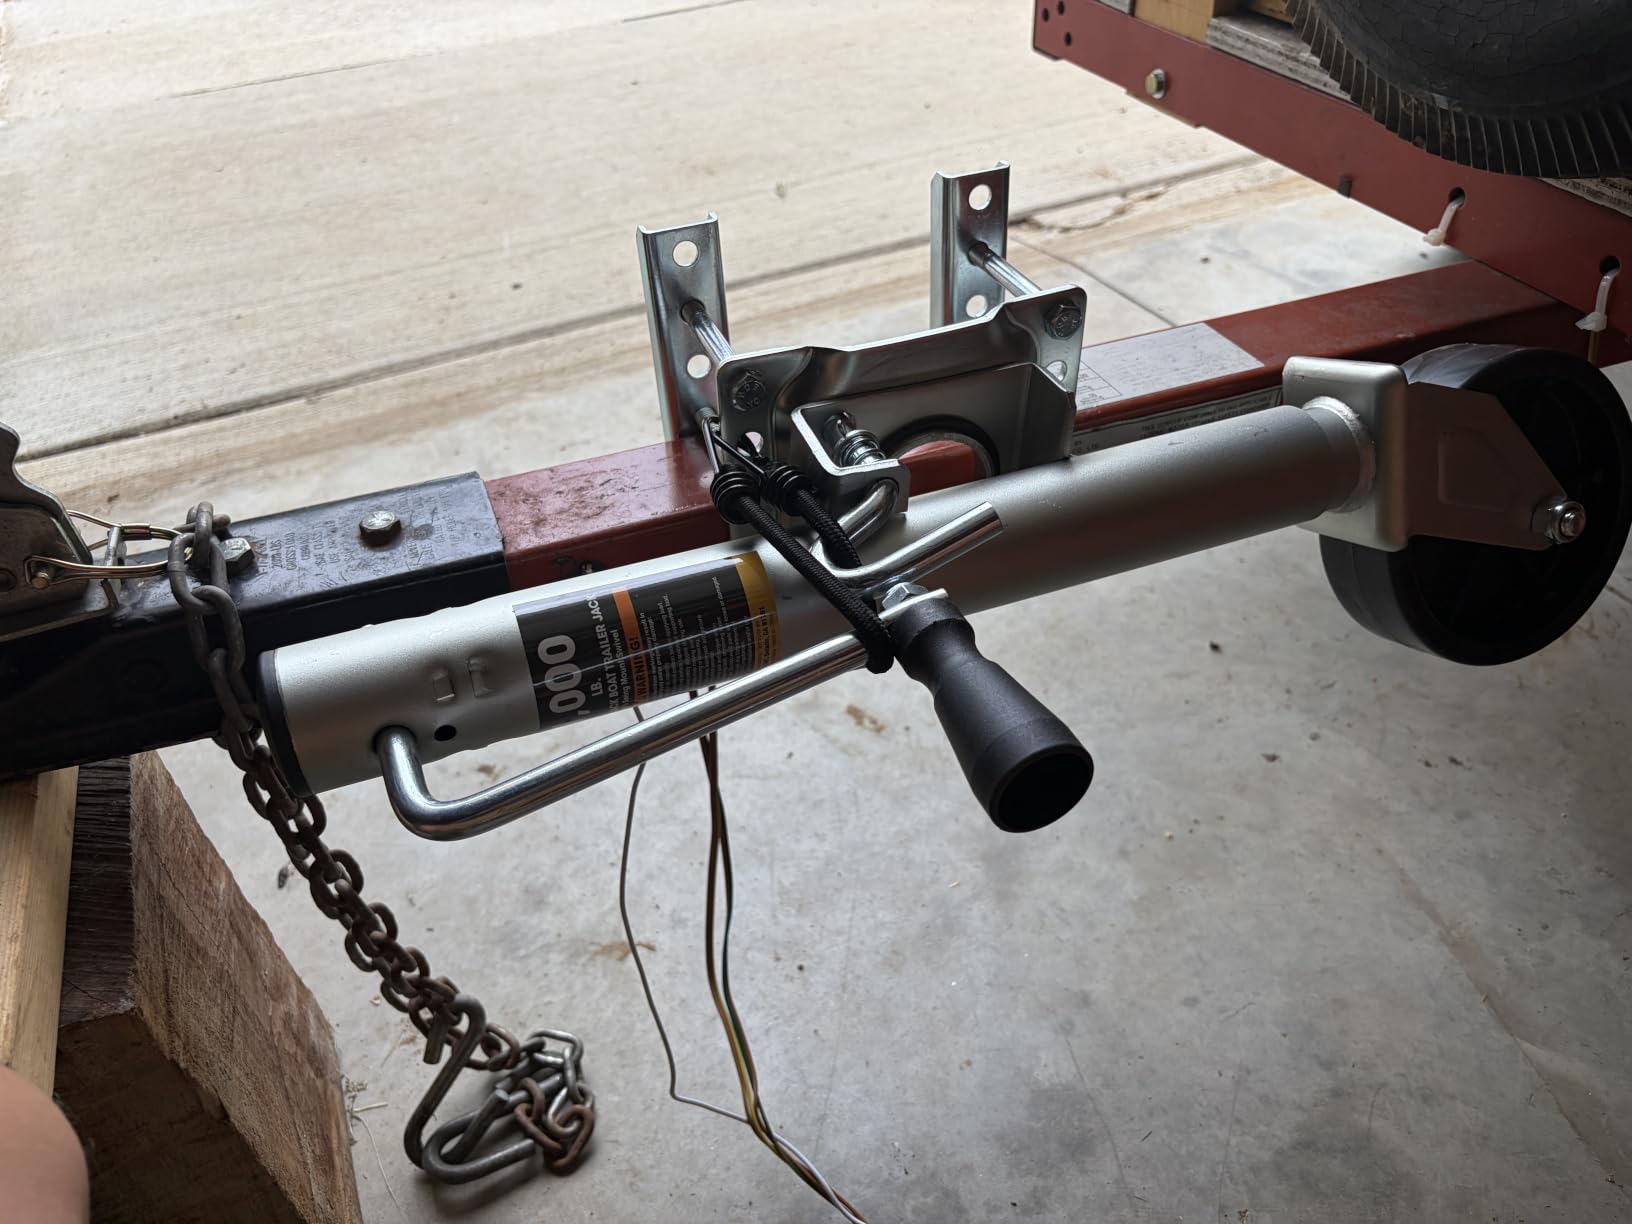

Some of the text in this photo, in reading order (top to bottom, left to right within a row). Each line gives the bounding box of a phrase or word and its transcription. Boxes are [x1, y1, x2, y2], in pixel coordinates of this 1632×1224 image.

[587, 594, 603, 621] JACK
[596, 624, 614, 670] TRAILER
[610, 629, 623, 657] Swivel
[618, 660, 627, 685] Mount
[630, 637, 646, 696] WARNING!
[590, 678, 603, 696] LB.
[606, 672, 618, 697] BOAT
